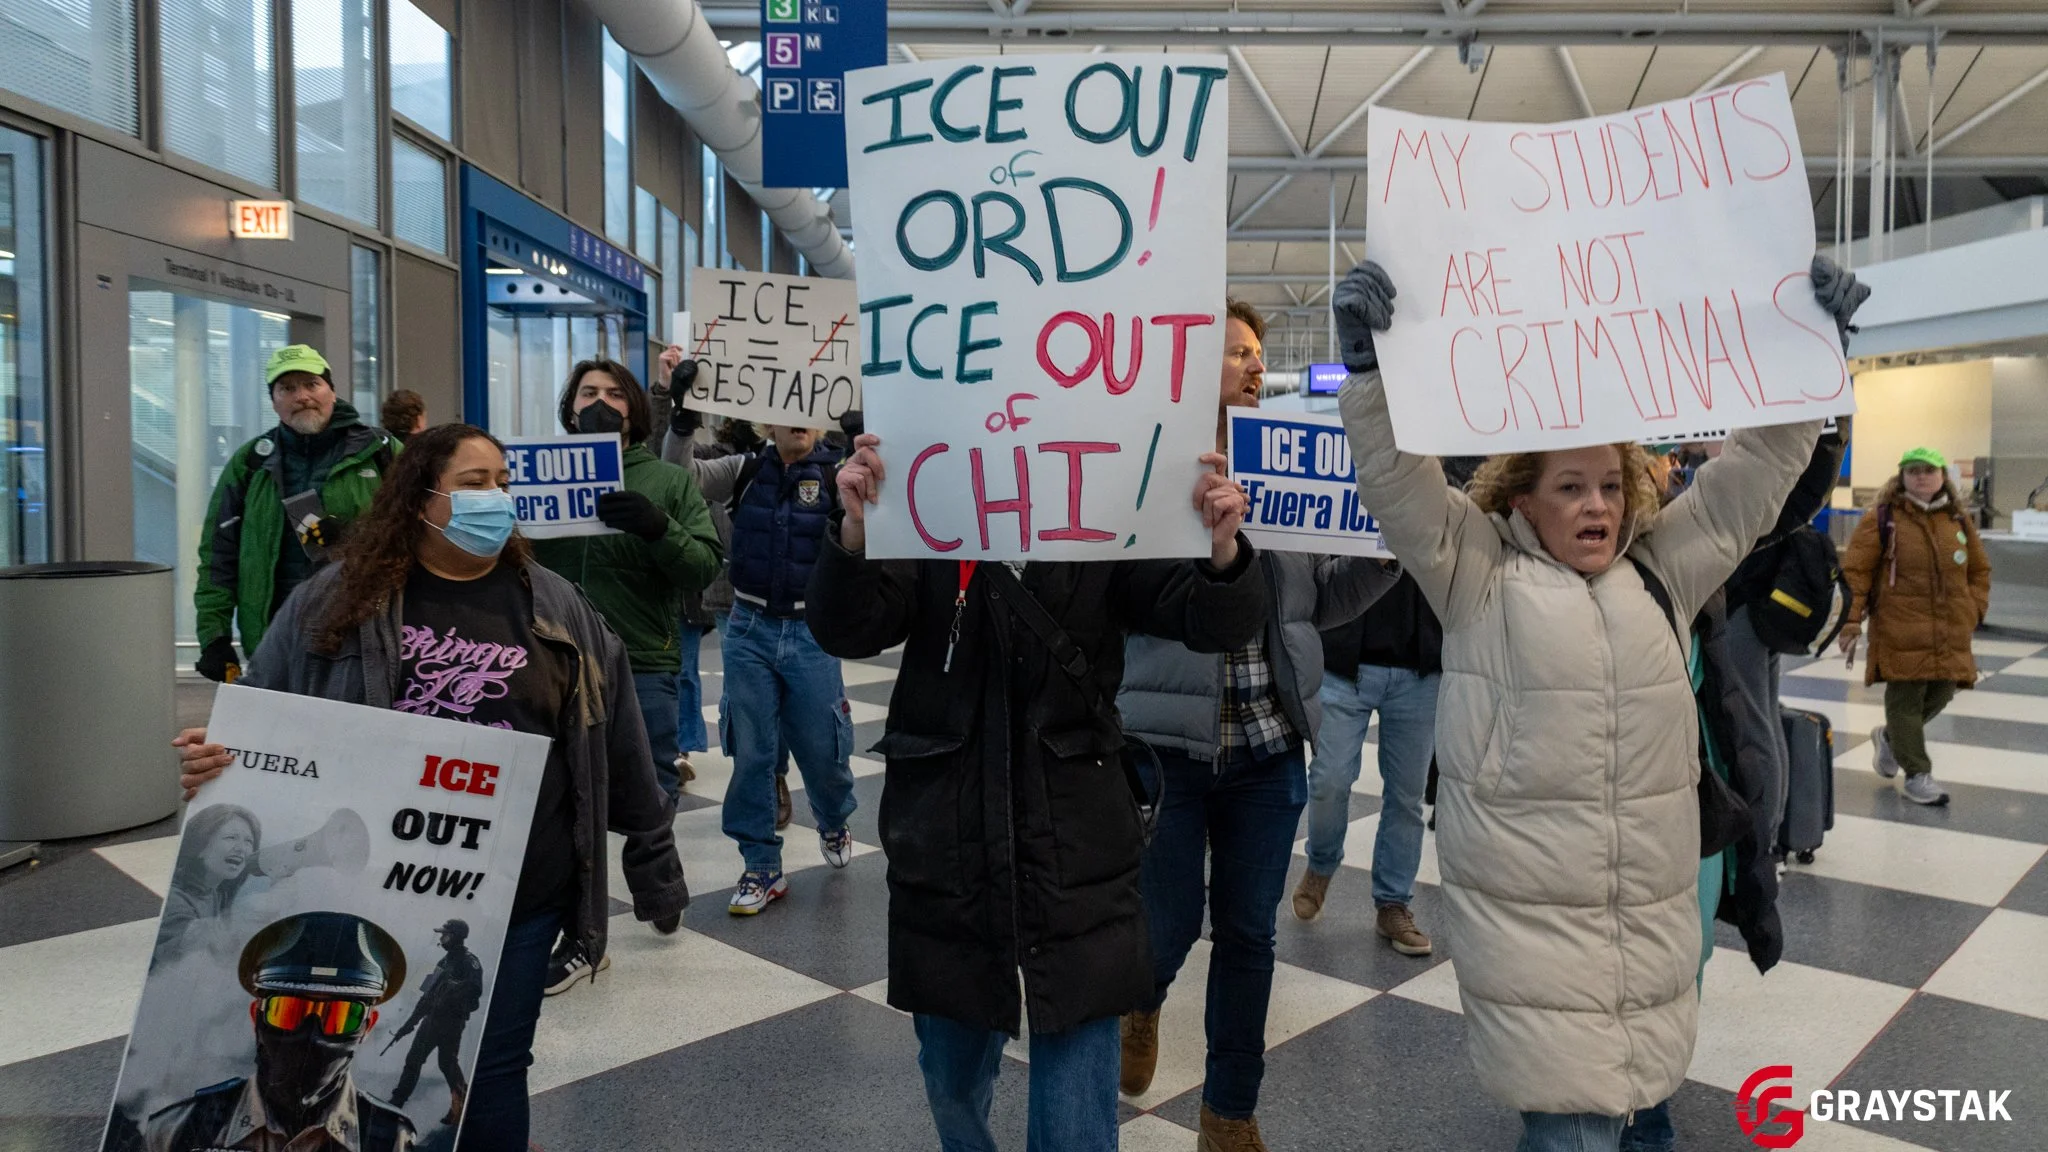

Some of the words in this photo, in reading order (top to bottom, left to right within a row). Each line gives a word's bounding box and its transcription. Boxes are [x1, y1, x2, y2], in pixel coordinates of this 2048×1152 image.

[808, 7, 818, 21] K
[825, 8, 835, 22] L
[775, 38, 792, 63] 5
[806, 35, 820, 49] M
[773, 82, 794, 108] P
[863, 64, 1036, 153] ICE
[1064, 62, 1228, 162] OUT
[1384, 128, 1470, 210] MY
[1510, 81, 1791, 212] STUDENTS
[240, 206, 282, 233] EXIT
[896, 166, 1165, 286] ORD!
[164, 257, 208, 283] Terminal
[1441, 248, 1523, 317] ARE
[1558, 231, 1645, 309] NOT
[718, 280, 810, 326] ICE
[860, 294, 1002, 384] ICE
[1036, 310, 1215, 402] OUT
[1451, 272, 1845, 435] CRIMINALS
[690, 358, 853, 421] GESTAPO
[505, 449, 531, 482] CE
[535, 446, 597, 482] OUT!
[1261, 426, 1306, 474] ICE
[1314, 432, 1351, 478] OU
[567, 486, 615, 519] IC
[907, 422, 1162, 552] CHI!
[419, 754, 500, 797] ICE
[392, 807, 491, 850] OUT
[383, 861, 485, 900] NOW!
